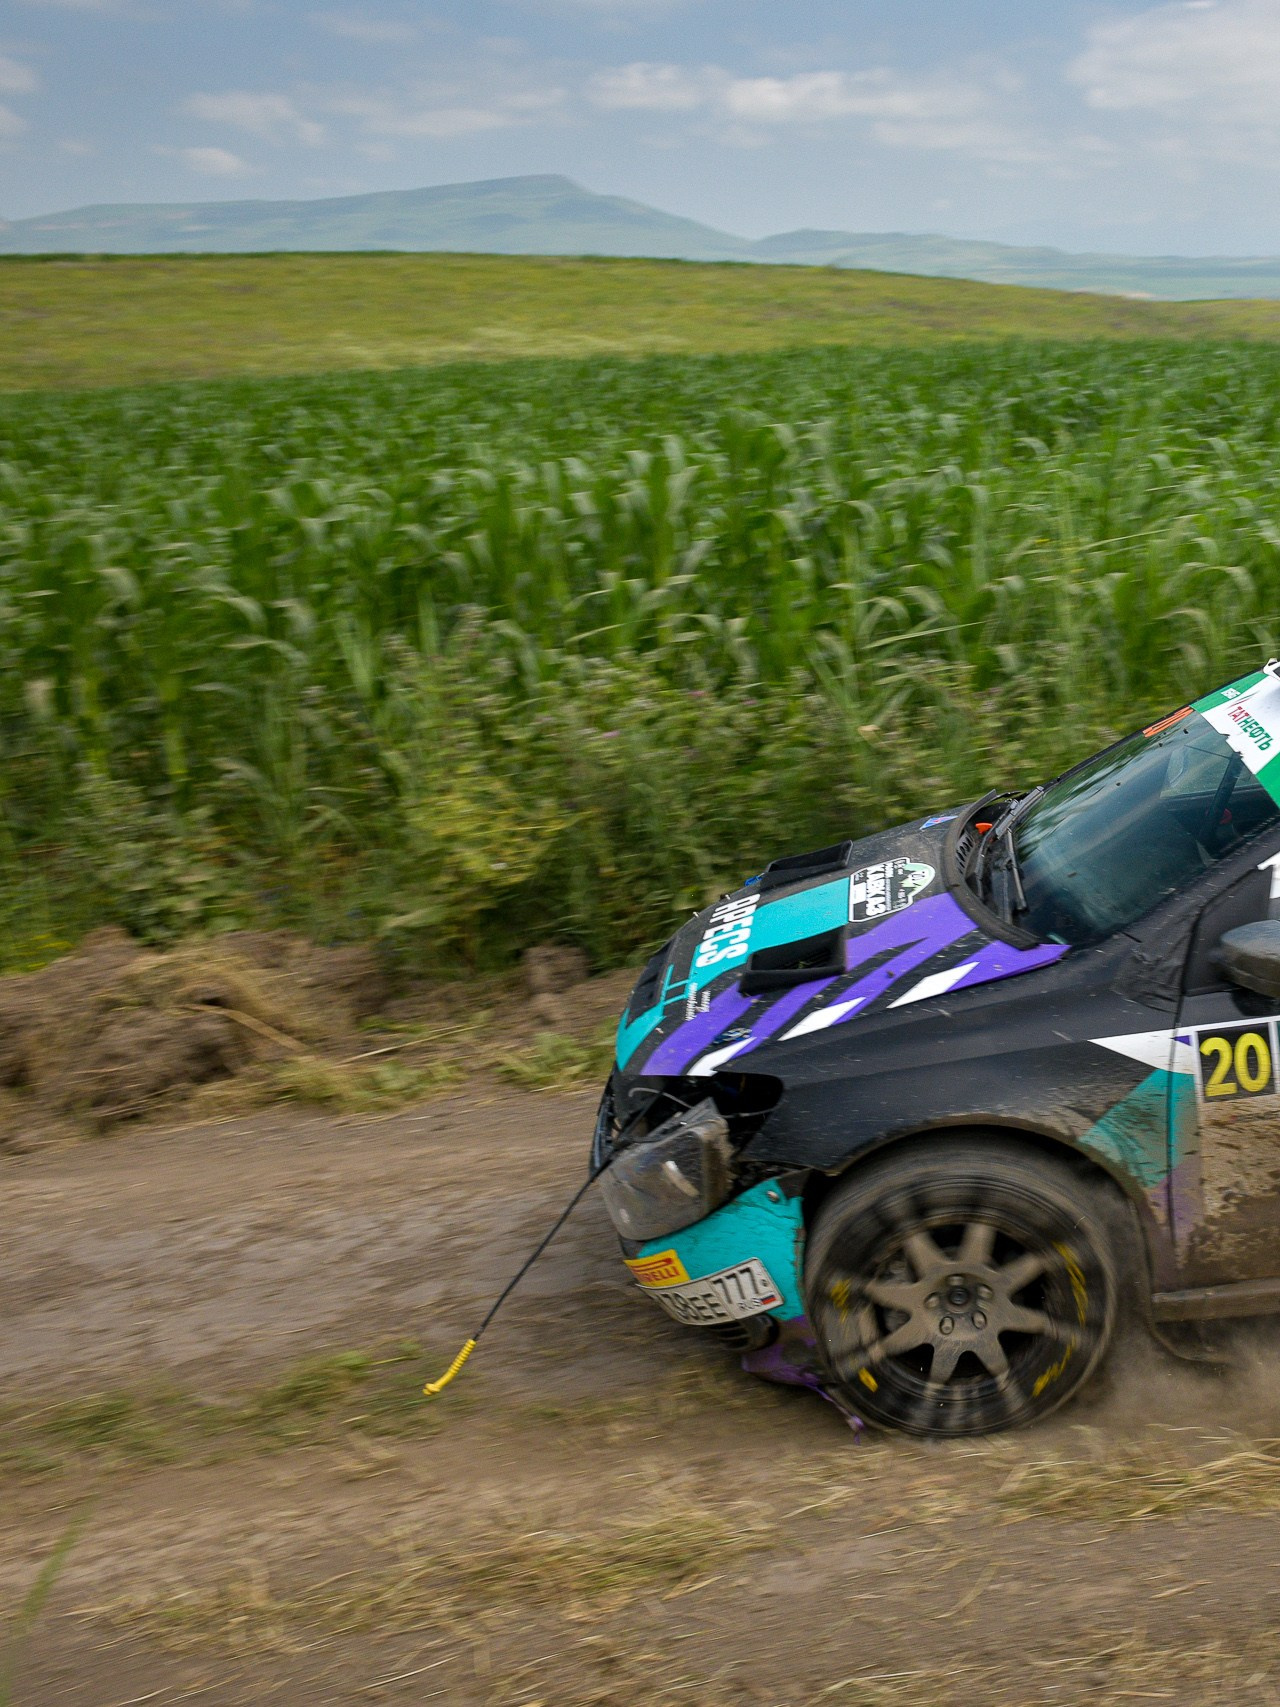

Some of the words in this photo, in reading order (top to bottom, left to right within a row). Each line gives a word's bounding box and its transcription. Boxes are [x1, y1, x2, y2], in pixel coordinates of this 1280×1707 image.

[1226, 705, 1272, 751] ТАТНЕФТЬ
[695, 893, 761, 968] APECS
[1200, 1032, 1271, 1097] 20
[712, 1267, 760, 1305] 777
